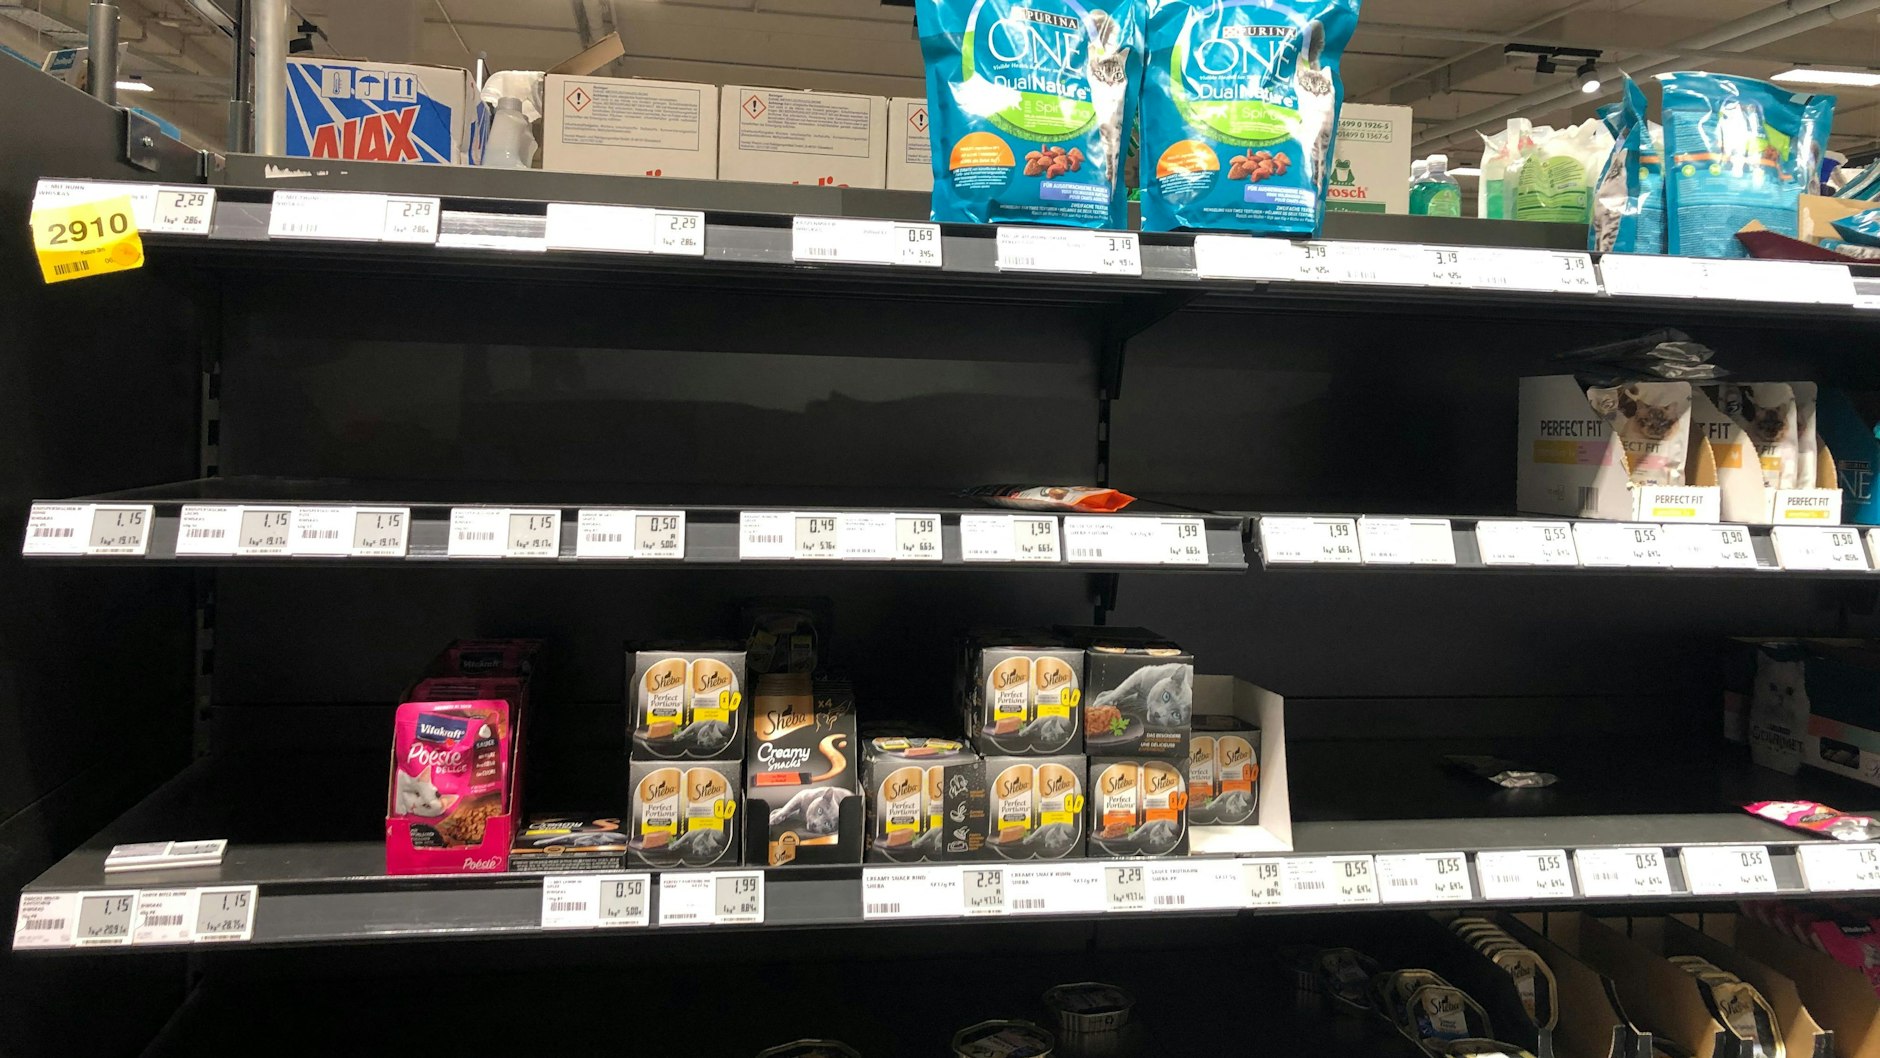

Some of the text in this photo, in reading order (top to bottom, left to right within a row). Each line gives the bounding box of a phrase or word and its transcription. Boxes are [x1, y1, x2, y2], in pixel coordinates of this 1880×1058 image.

[1028, 10, 1076, 28] PURINA
[988, 19, 1083, 73] ONE
[1198, 38, 1294, 82] ONE
[312, 105, 421, 161] AJAX
[1327, 186, 1366, 198] rosch
[175, 193, 205, 208] 2.29
[403, 203, 431, 217] 2.29
[48, 212, 128, 245] 2910
[670, 217, 696, 230] 2.29
[909, 229, 932, 242] 0.69
[1109, 238, 1131, 251] 3.19
[1304, 246, 1325, 258] 3.19
[1436, 252, 1457, 264] 3.19
[1564, 258, 1584, 270] 3.19
[1541, 420, 1602, 437] PERFECT FIT
[1708, 422, 1730, 439] FIT
[1839, 470, 1874, 500] NE
[1655, 494, 1704, 504] PERFECT FIT
[1788, 497, 1830, 506] PERFECT FIT
[117, 512, 142, 526] 1.15
[264, 512, 287, 527] 1.15
[377, 514, 400, 529] 1.15
[529, 516, 551, 530] 1.15
[651, 517, 676, 532] 0.50
[810, 519, 834, 533] 0.49
[914, 520, 933, 534] 1.99
[1031, 522, 1050, 536] 1.99
[1178, 525, 1197, 538] 1.99
[1330, 524, 1348, 538] 1.99
[1544, 528, 1566, 541] 0.55
[1634, 530, 1656, 542] 0.55
[1722, 532, 1742, 544] 0.90
[1832, 534, 1853, 546] 0.90
[652, 672, 681, 690] Sheba
[700, 672, 728, 690] Sheba
[1000, 672, 1026, 688] Sheba
[1044, 672, 1068, 688] Sheba
[653, 694, 678, 702] Perfect
[1000, 691, 1023, 699] Perfect
[818, 700, 832, 708] x4
[765, 706, 806, 735] Sheba
[420, 724, 462, 738] Vitakraft
[758, 742, 811, 762] Creamy
[1225, 752, 1249, 766] Sheba
[768, 758, 801, 772] Snacks
[1107, 777, 1134, 793] Sheba
[1150, 777, 1176, 792] Sheba
[1189, 774, 1210, 782] ortions
[646, 782, 676, 800] Sheba
[695, 782, 723, 800] Sheba
[890, 782, 918, 799] Sheba
[1004, 780, 1029, 797] Sheba
[1047, 780, 1072, 796] Sheba
[648, 804, 672, 812] Perfect
[889, 808, 919, 816] Portions
[892, 802, 915, 810] Perfect
[1001, 805, 1030, 813] Portions
[1106, 801, 1135, 809] Portions
[645, 809, 676, 817] Portions
[463, 857, 496, 870] Poésie
[774, 852, 793, 866] Sheba
[1538, 856, 1560, 871] 0.55
[1636, 854, 1657, 869] 0.55
[1741, 851, 1762, 866] 0.55
[1259, 864, 1277, 880] 1.99
[1345, 862, 1367, 876] 0.55
[1438, 858, 1459, 874] 0.55
[977, 872, 1000, 887] 2.29
[1116, 867, 1141, 884] 2.29
[616, 882, 642, 898] 0.50
[736, 878, 756, 894] 1.99
[104, 897, 130, 915] 1.15
[221, 894, 246, 910] 1.15
